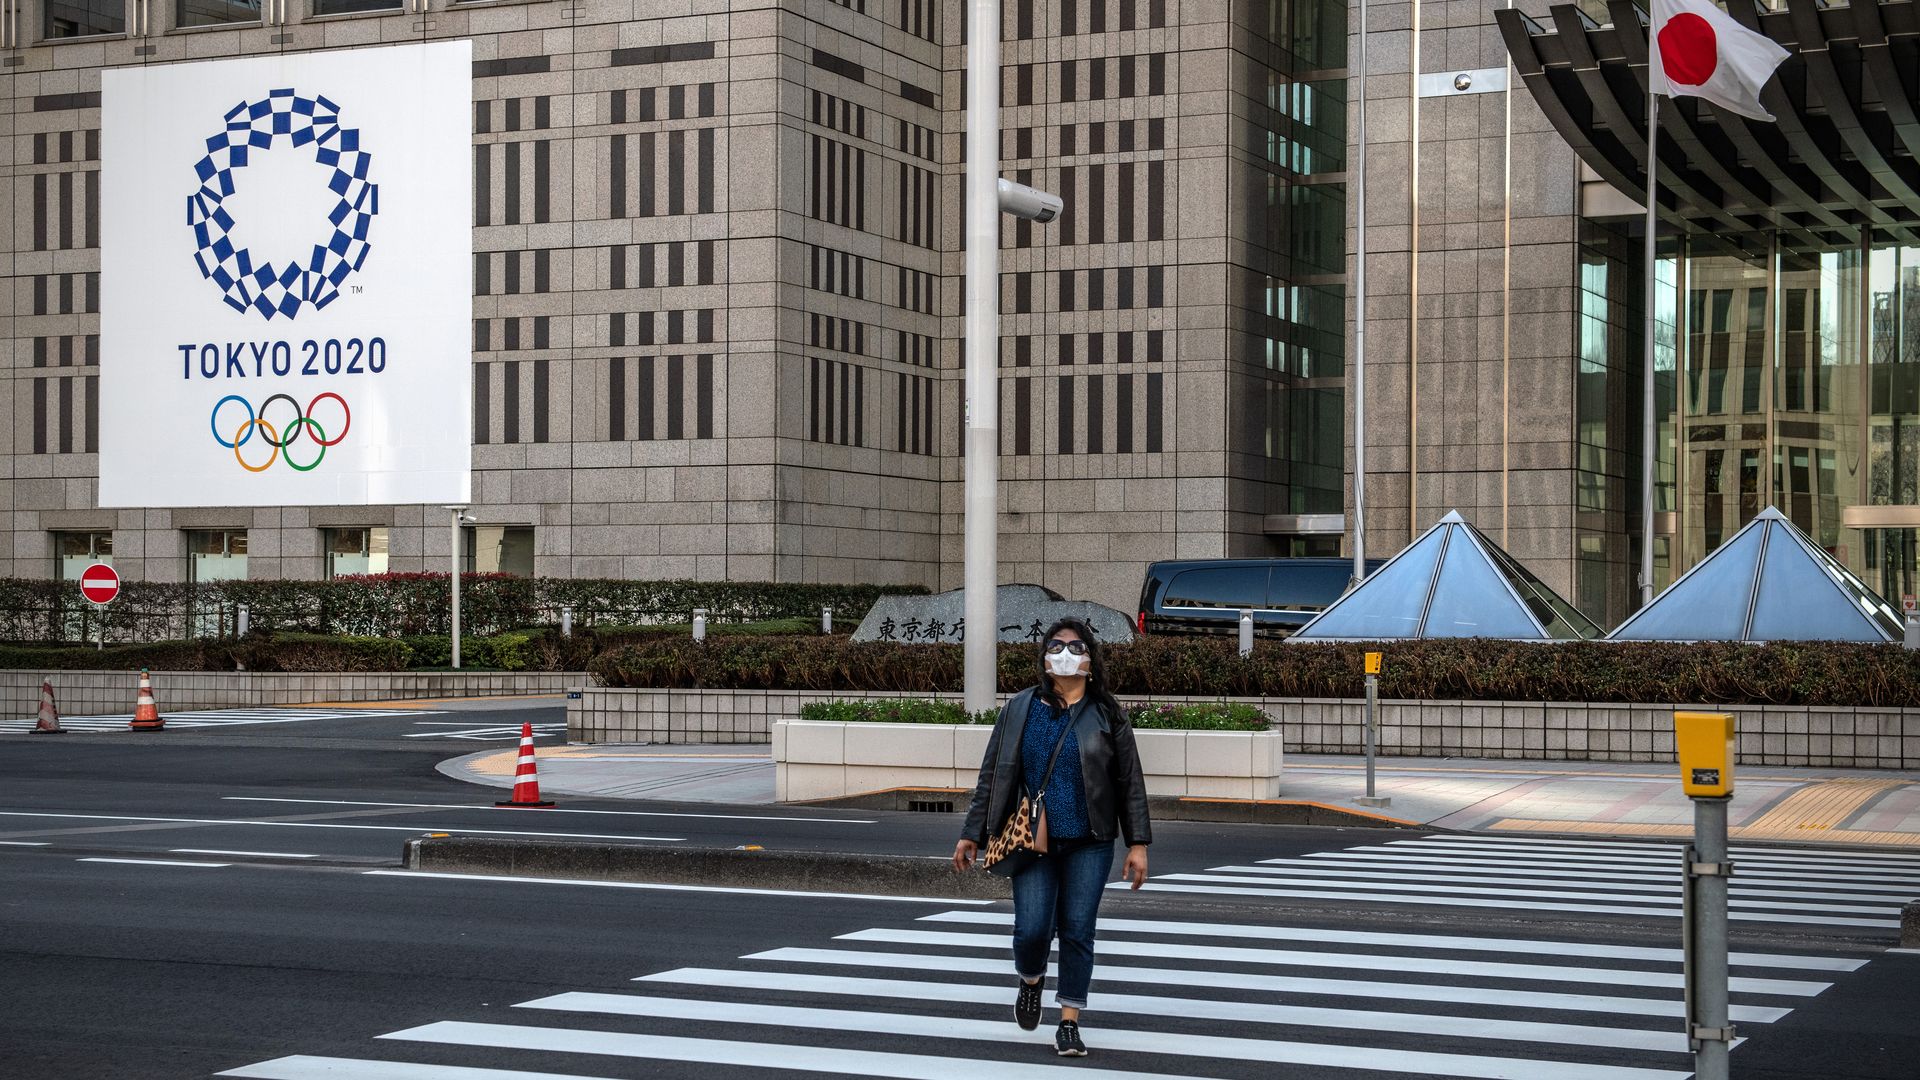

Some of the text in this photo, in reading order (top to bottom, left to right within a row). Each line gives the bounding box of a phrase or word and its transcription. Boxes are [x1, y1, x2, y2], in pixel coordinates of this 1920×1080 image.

[351, 286, 363, 294] TM
[178, 337, 386, 379] TOKYO 2020
